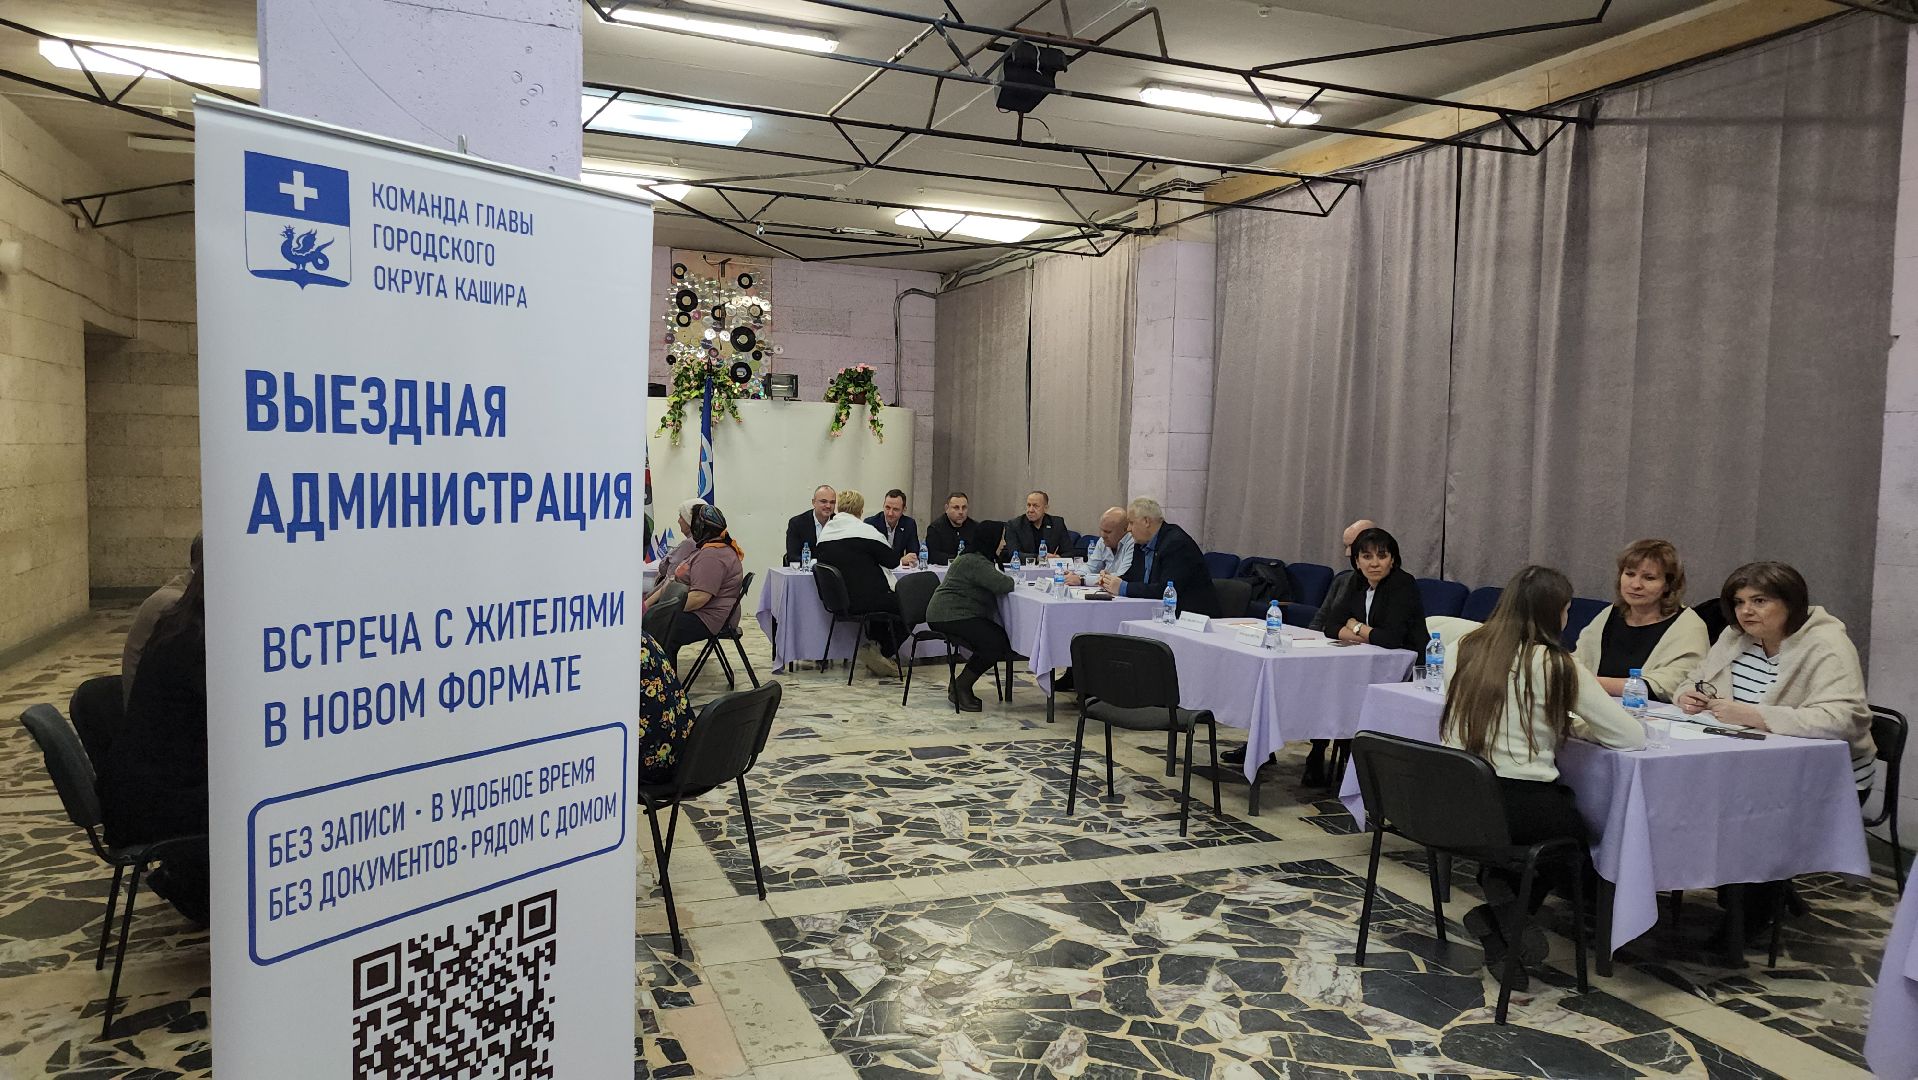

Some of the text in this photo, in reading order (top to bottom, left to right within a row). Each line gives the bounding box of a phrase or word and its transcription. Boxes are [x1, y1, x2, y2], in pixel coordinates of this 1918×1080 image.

[371, 182, 535, 237] КОМАНДА ГЛАВЫ
[372, 223, 496, 268] ГОРОДСКОГО
[373, 264, 528, 309] ОКРУГА КАШИРА
[244, 368, 507, 446] ВЫЕЗДНАЯ
[246, 470, 633, 544] АДМИНИСТРАЦИЯ
[262, 590, 625, 673] ВСТРЕЧА С ЖИТЕЛЯМИ
[263, 654, 583, 748] В НОВОМ ФОРМАТЕ
[268, 755, 596, 868] БЕЗ ЗАПИСИ В УДОБНОЕ ВРЕМЯ
[268, 792, 618, 922] БЕЗ ДОКУМЕНТОВ РЯДОМ С ДОМОМ
